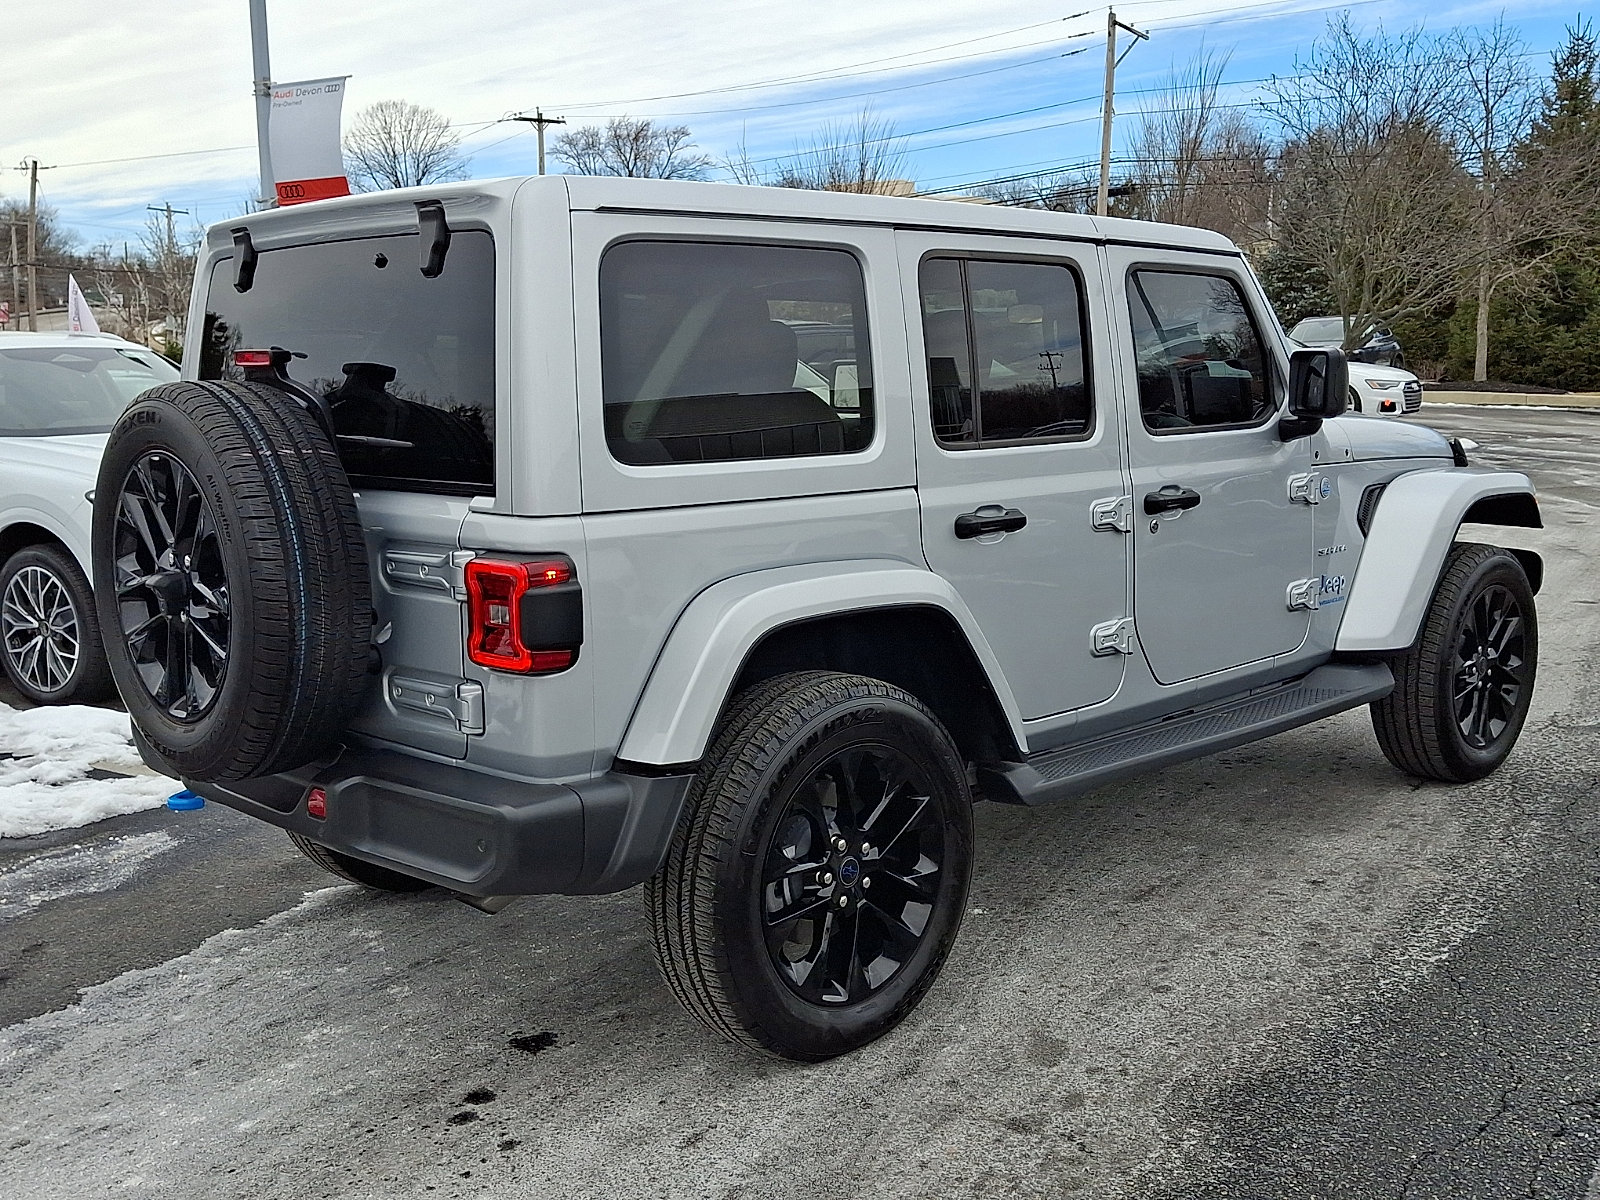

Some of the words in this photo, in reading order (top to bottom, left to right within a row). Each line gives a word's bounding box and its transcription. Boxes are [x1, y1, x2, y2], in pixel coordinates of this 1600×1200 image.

[273, 91, 294, 99] Audi
[296, 88, 321, 97] Devon
[273, 100, 302, 108] Pre-Owned
[1319, 574, 1346, 595] Jeep
